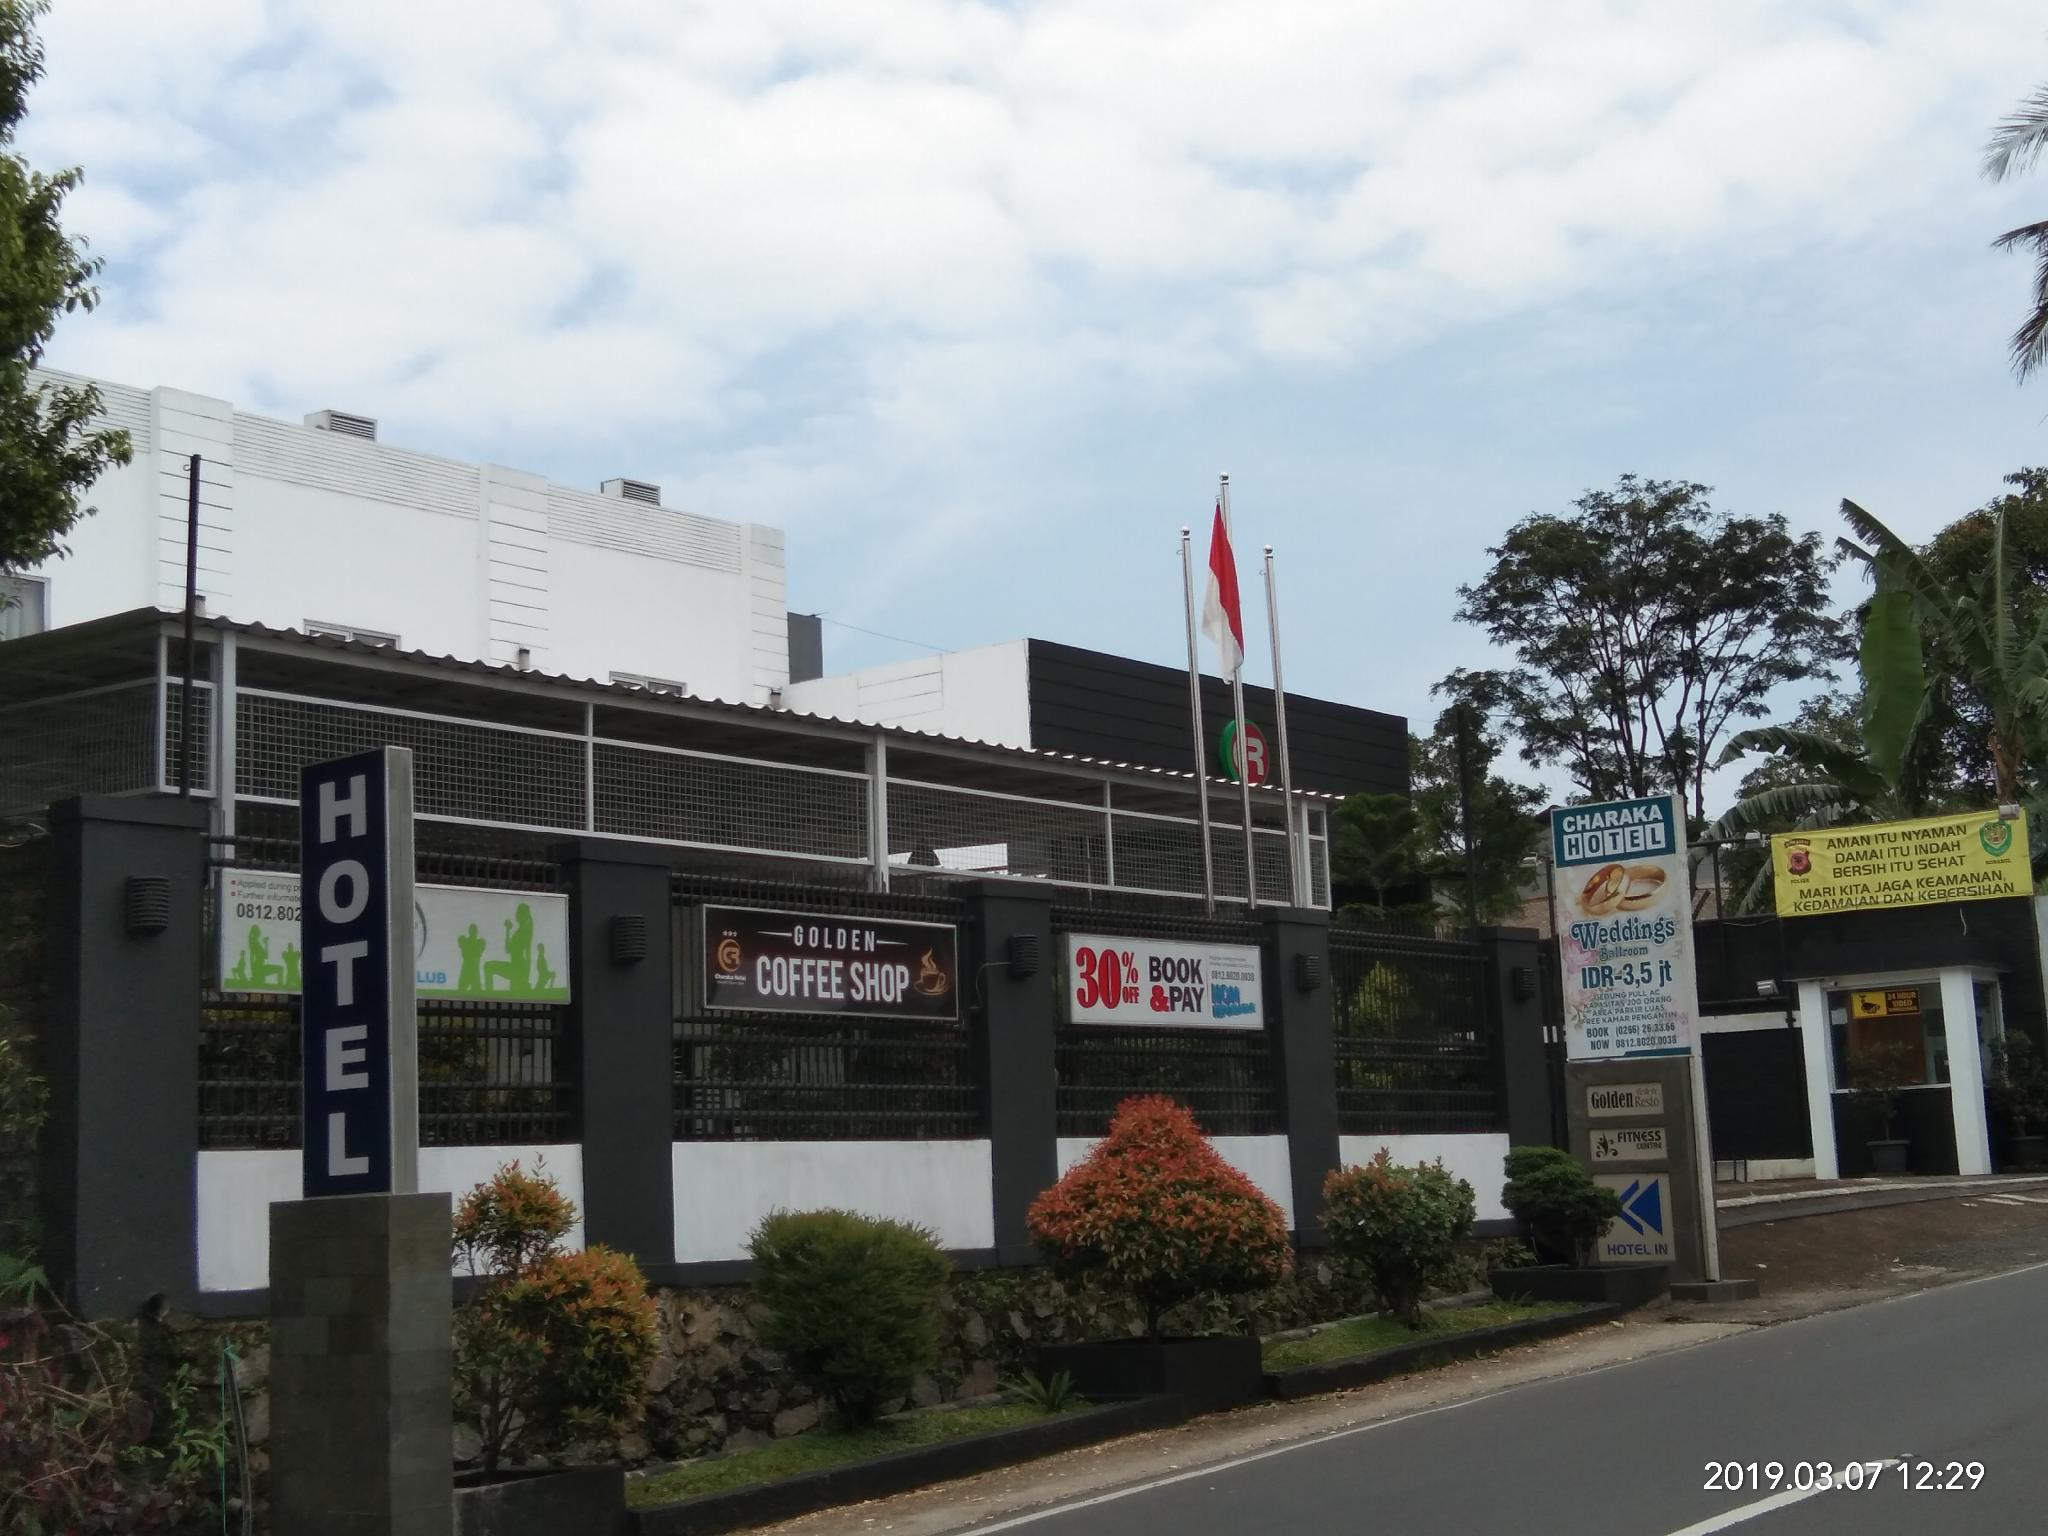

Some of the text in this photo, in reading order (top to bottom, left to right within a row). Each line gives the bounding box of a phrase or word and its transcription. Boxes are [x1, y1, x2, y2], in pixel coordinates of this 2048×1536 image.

[1563, 804, 1663, 833] CHARAKA
[1566, 826, 1663, 857] HOTEL
[1827, 834, 1871, 850] AMAN
[1875, 832, 1897, 845] ITU
[1901, 824, 1967, 842] NYAMAN
[1835, 840, 1961, 864] DAMAI ITU INDAH
[1833, 855, 1967, 879] BERSIH ITU SEHAT
[1794, 882, 2015, 912] KEDAMAIAN DAN KEBERSIHAN
[1799, 885, 1836, 899] MARI
[1840, 883, 1871, 896] KITA
[1873, 879, 1913, 893] JAGA
[794, 925, 875, 952] GOLDEN
[1571, 917, 1675, 950] Weddings
[1600, 946, 1648, 961] Ballroom
[319, 774, 369, 1177] HOTEL
[756, 956, 910, 1002] COFFEE SHOP
[1149, 956, 1203, 984] BOOK
[1581, 960, 1672, 989] IDR-3,5 jt
[1121, 986, 1140, 1004] OFF
[1594, 991, 1627, 1000] GEDUNG
[1643, 996, 1673, 1004] ORANG
[1593, 1004, 1665, 1017] AREA PARKIR LUAS
[1602, 1015, 1631, 1023] KAMAR
[1632, 1011, 1678, 1021] PENGANTIN
[1587, 1027, 1609, 1038] BOOK
[1590, 1039, 1609, 1050] NOW
[1591, 1091, 1634, 1110] Golden
[1617, 1130, 1662, 1143] FITNESS
[1607, 1244, 1668, 1256] HOTEL IN
